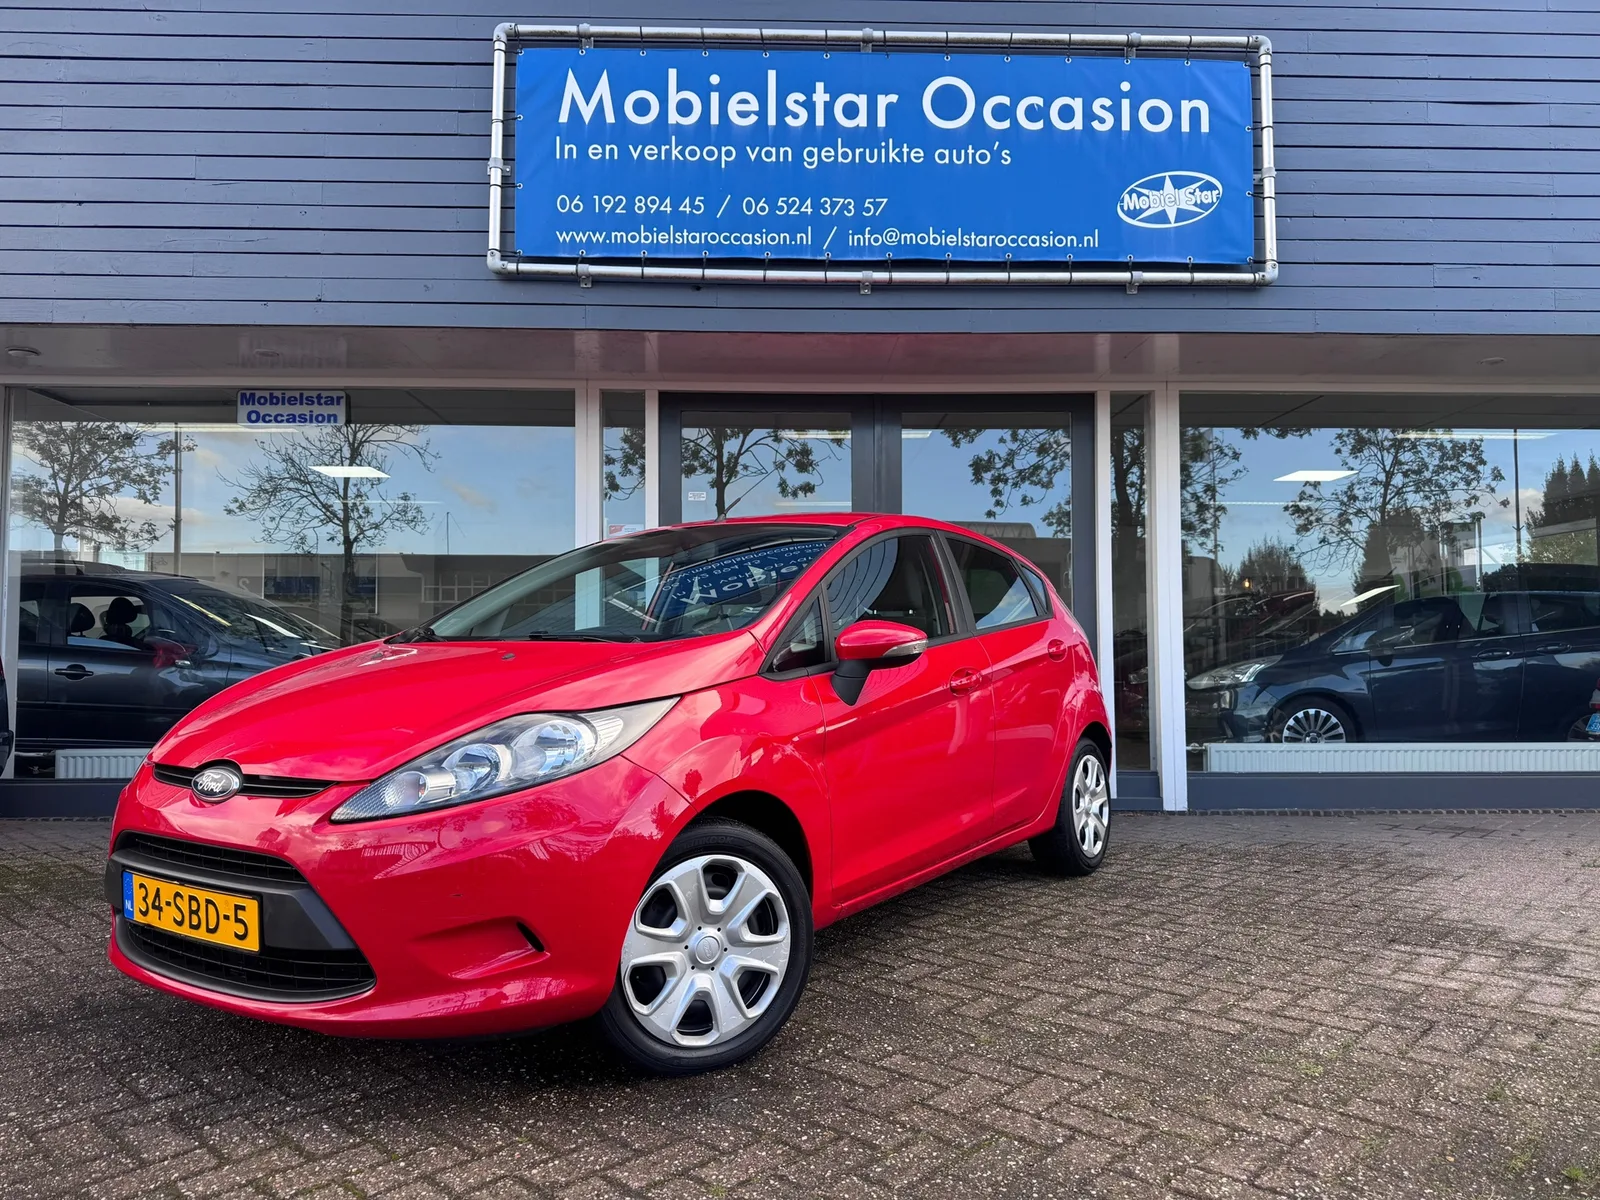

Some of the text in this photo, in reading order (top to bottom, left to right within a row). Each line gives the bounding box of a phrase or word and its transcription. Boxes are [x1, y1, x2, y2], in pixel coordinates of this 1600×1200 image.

[558, 67, 1210, 133] Mobielstar Occasion
[555, 136, 1012, 169] In en verkoop van gebruikte auto's
[556, 194, 889, 219] 06 192 894 45 / 06 524 373 57
[1123, 187, 1220, 211] Mobiel Star
[555, 225, 1099, 250] www.mobielstaroccasion.nl / info@mobielstaroccasion.nl
[240, 392, 344, 406] Mobielstar
[246, 410, 338, 424] Occasion
[198, 772, 223, 793] Ford
[125, 900, 134, 912] NL
[138, 882, 249, 941] 34-SBD-5
